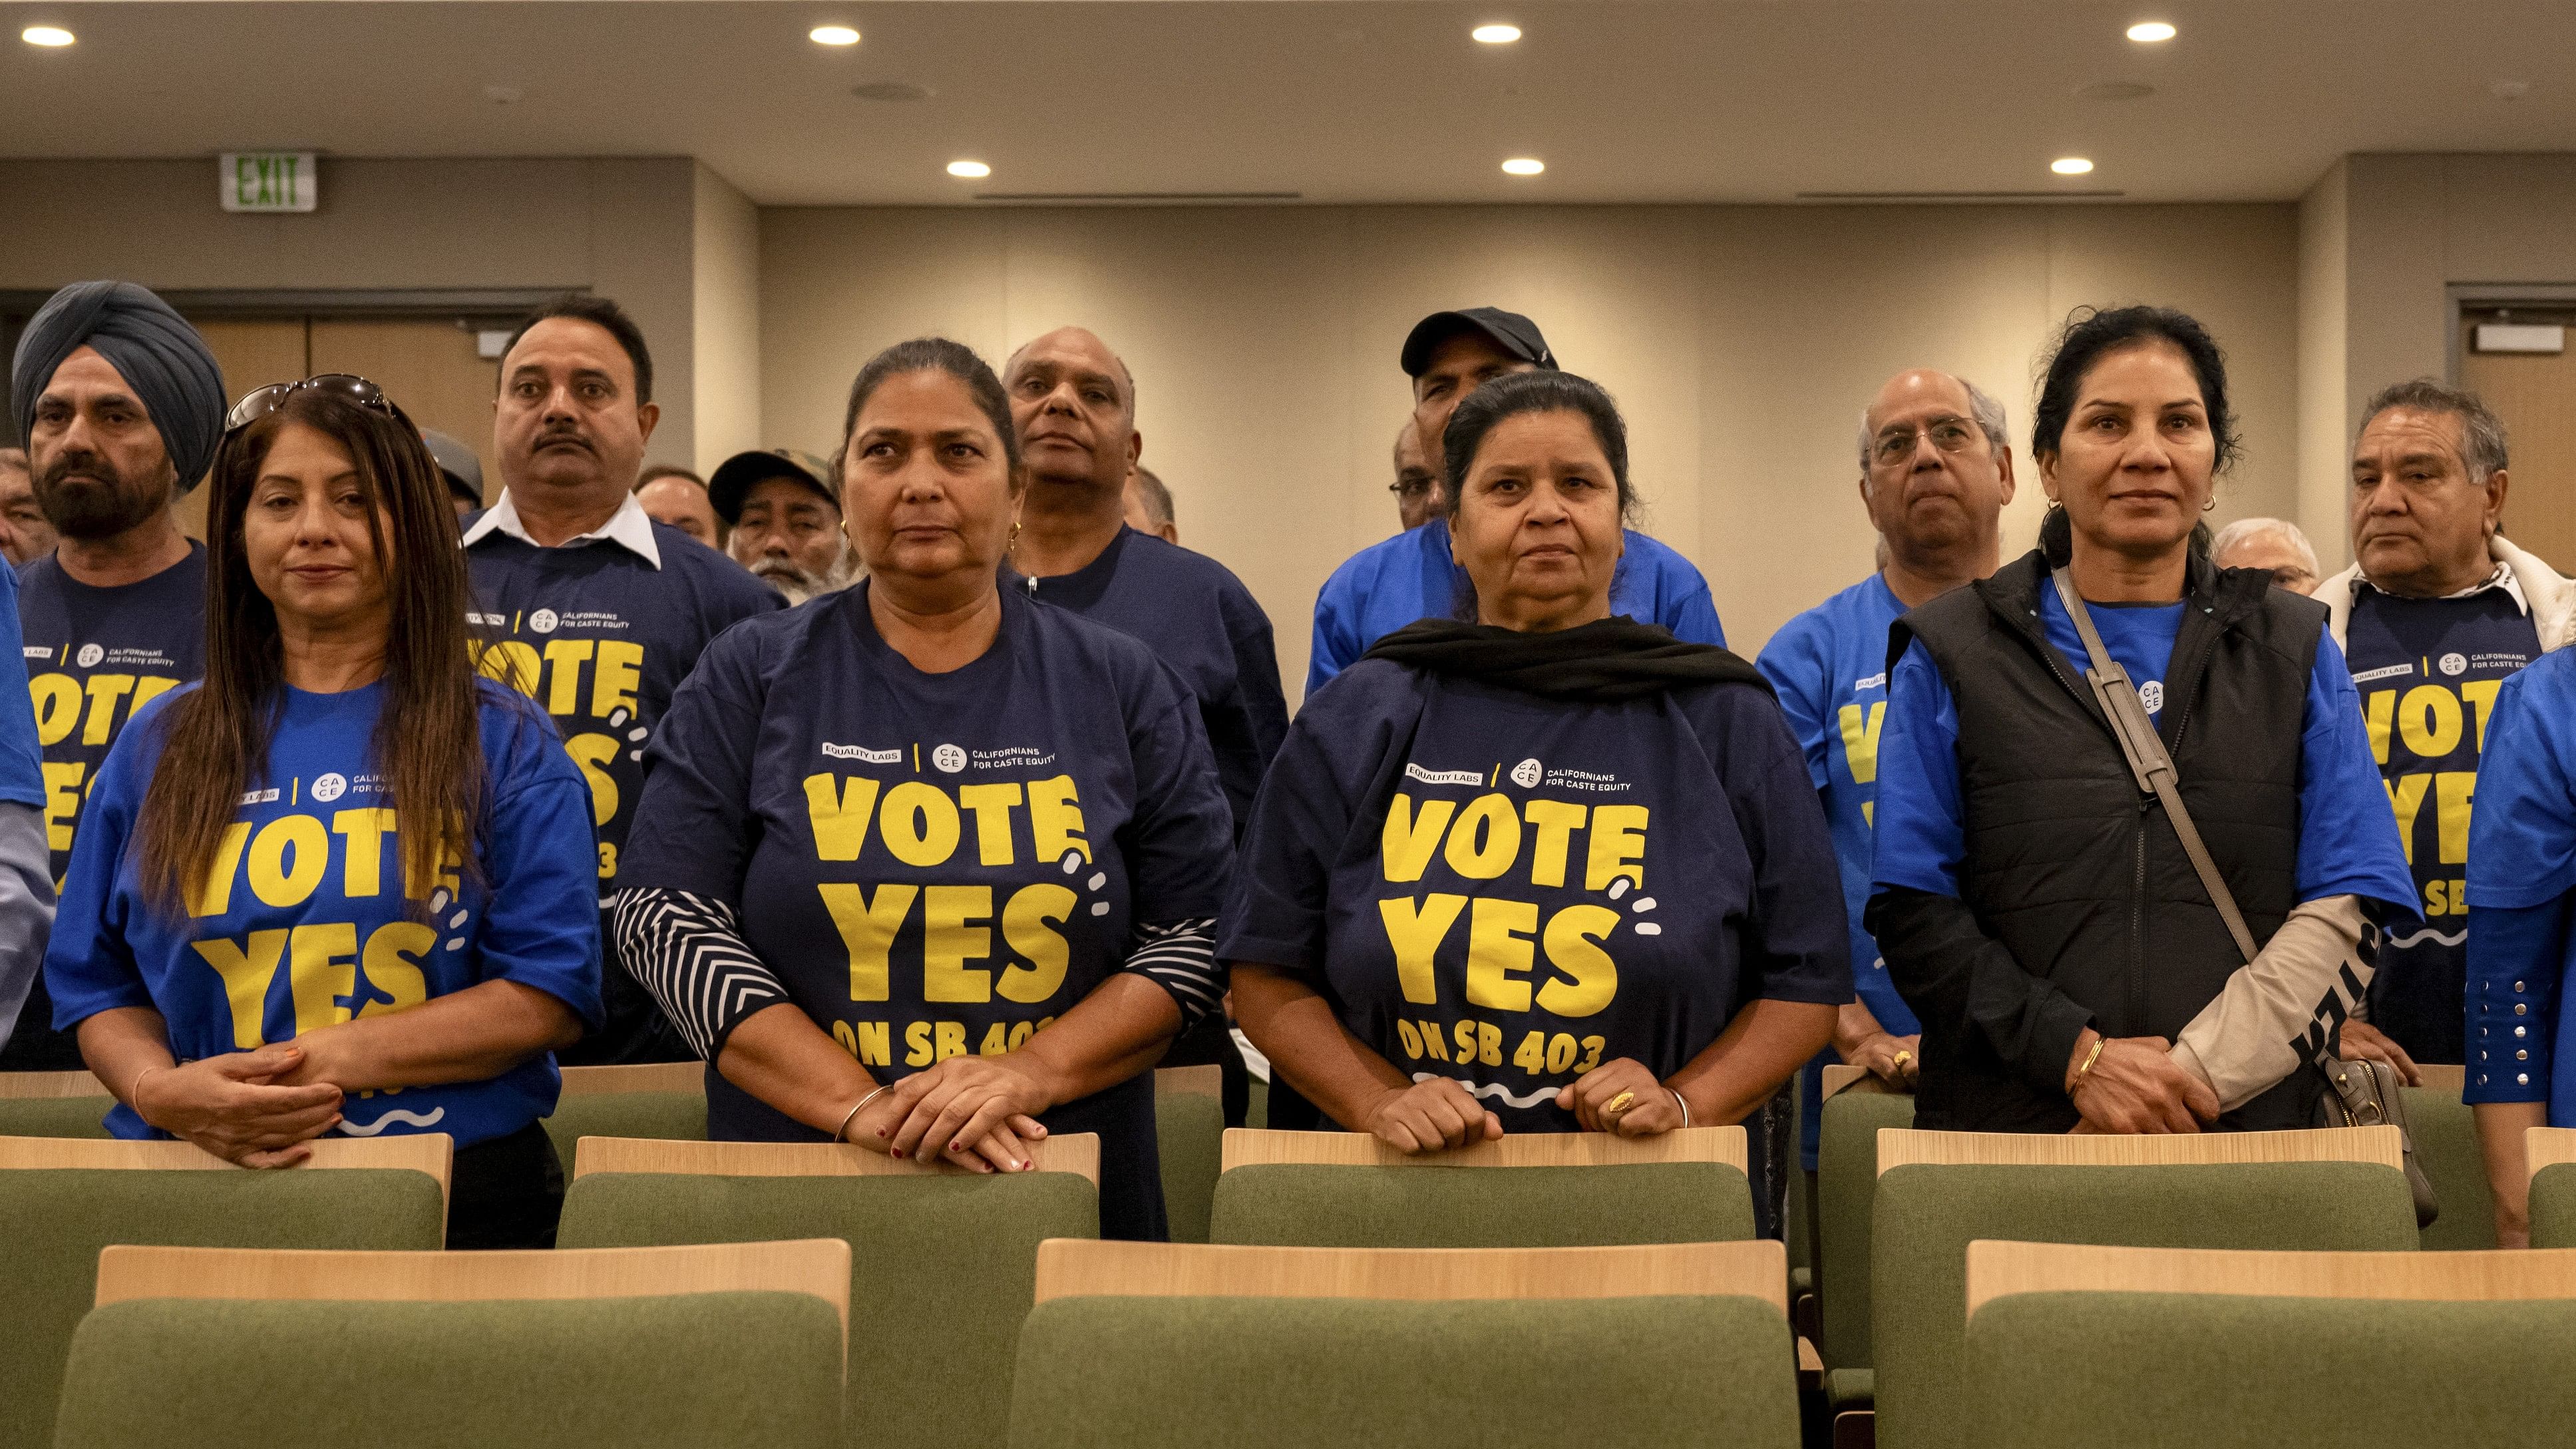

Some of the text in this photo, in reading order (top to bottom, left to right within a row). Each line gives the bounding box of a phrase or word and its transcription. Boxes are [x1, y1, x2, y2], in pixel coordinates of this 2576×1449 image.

[236, 156, 299, 206] EXIT
[825, 745, 898, 761] EQUALITY LABS
[972, 747, 1039, 759] CALIFORNIANS
[974, 753, 1055, 769] FOR CASTE EQUITY
[1409, 766, 1479, 783] EQUALITY LABS
[1547, 769, 1614, 781] CALIFORNIANS
[353, 785, 371, 793] FOR
[1566, 780, 1596, 791] CASTE
[1598, 783, 1631, 791] EQUITY
[803, 772, 1093, 867] VOTE
[1381, 792, 1650, 891] VOTE
[817, 883, 1078, 1004] YES
[1378, 893, 1621, 1018] YES
[190, 921, 438, 1050] YES
[905, 1020, 968, 1068] SB
[1397, 1018, 1606, 1075] ON SB 403
